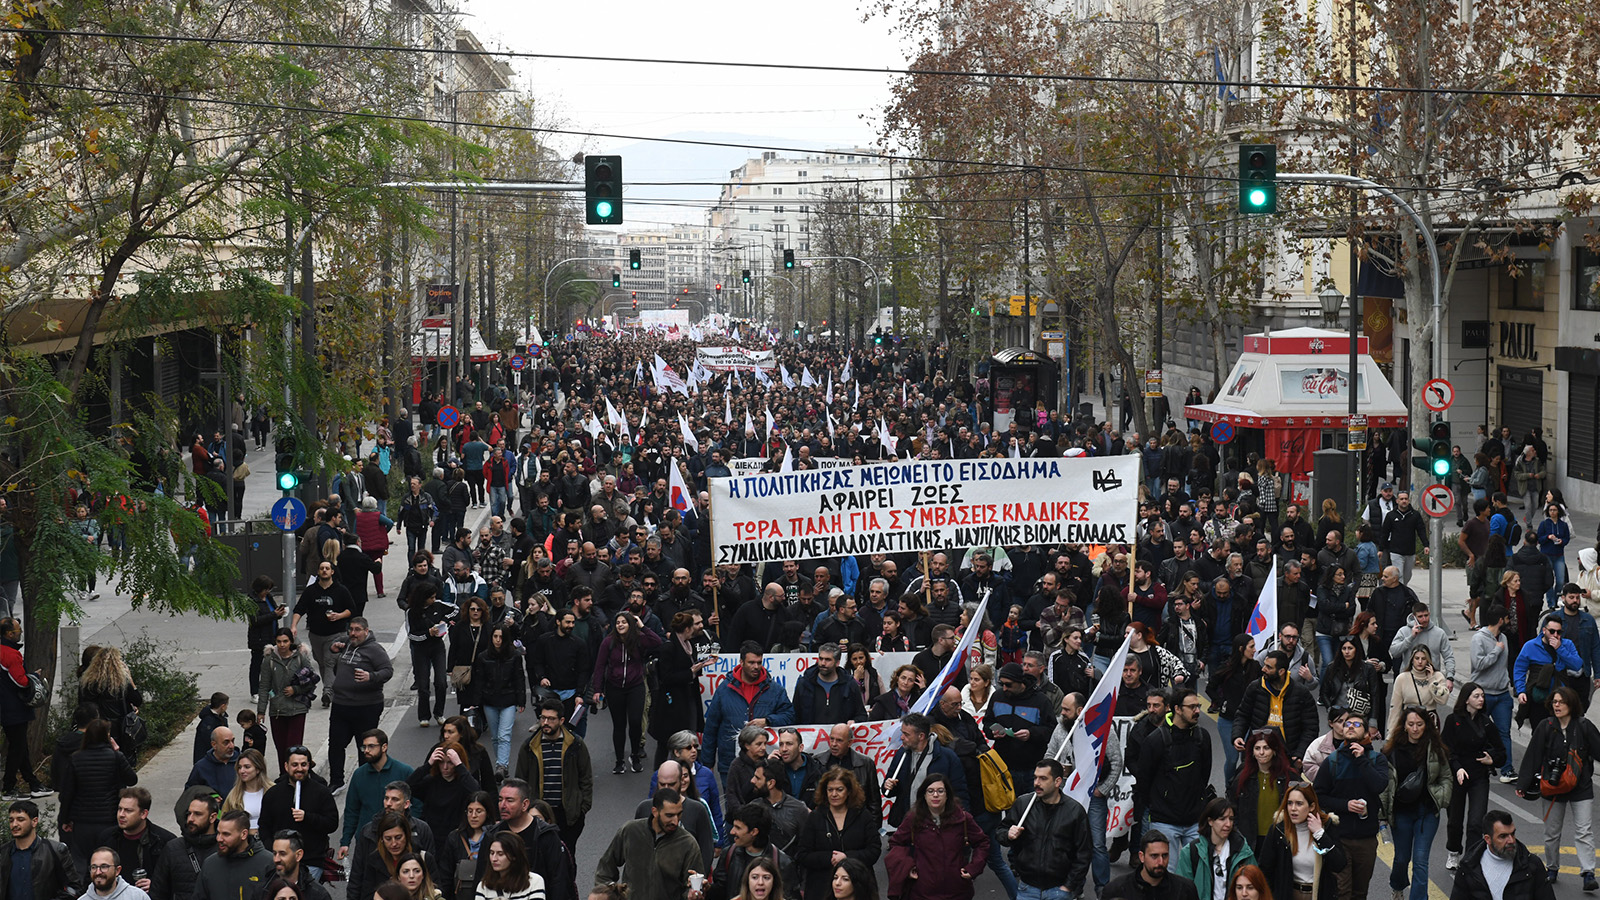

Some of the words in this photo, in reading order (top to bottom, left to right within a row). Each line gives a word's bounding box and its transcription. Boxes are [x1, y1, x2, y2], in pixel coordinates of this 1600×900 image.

[1465, 329, 1486, 337] PAUL
[1499, 321, 1538, 362] PAUL
[728, 478, 740, 499] Η
[860, 464, 928, 487] ΜΕΙΩΝΕΙ
[931, 461, 954, 483] ΤΟ
[959, 460, 1062, 482] ΕΙΣΟΔΗΜΑ
[821, 461, 837, 469] ΠΟΥ
[818, 487, 894, 514] ΑΦΑΙΡΕΙ
[910, 483, 964, 506] ΖΩΕΣ
[732, 518, 783, 541] ΤΩΡΑ
[788, 512, 843, 537] ΠΑΛΗ
[849, 510, 881, 533] ΓΙΑ
[888, 503, 998, 531] ΣΥΜΒΑΣΕΙΣ
[1002, 500, 1090, 523] ΚΛΑΔΙΚΕΣ
[717, 538, 797, 564] ΣΥΝΔΙΚΑΤΟ
